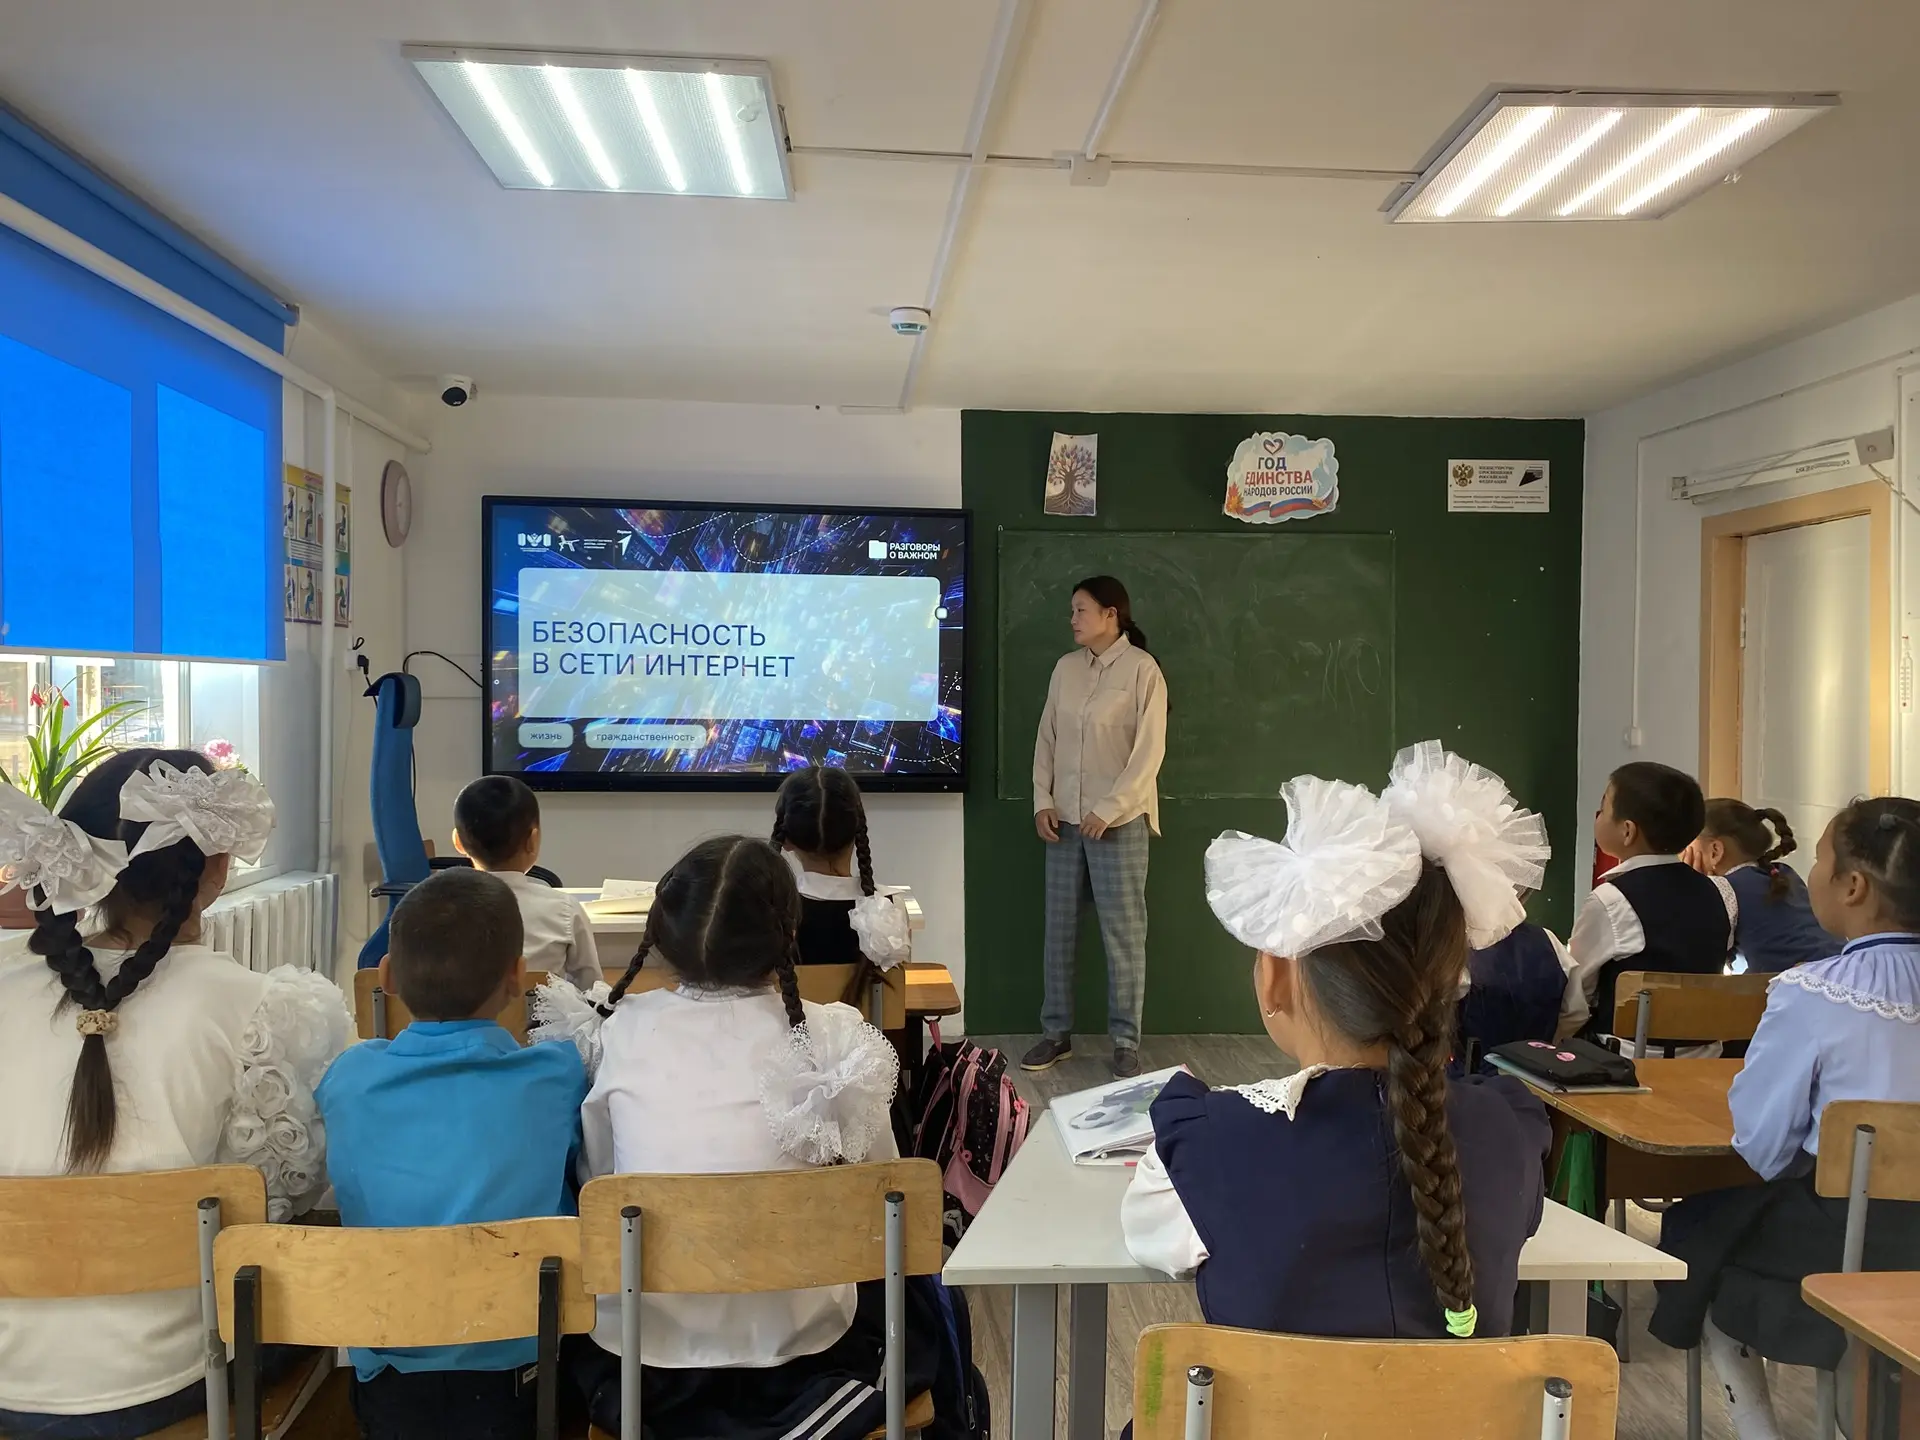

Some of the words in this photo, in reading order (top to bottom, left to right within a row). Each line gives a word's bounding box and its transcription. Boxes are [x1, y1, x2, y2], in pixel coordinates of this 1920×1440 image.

[1258, 457, 1287, 471] ГОД
[1245, 470, 1313, 487] ЕДИНСТВА
[1243, 487, 1277, 497] НАРОДОВ
[1279, 486, 1313, 495] РОССИИ
[890, 543, 941, 551] РАЗГОВОРЫ
[889, 551, 896, 559] О
[898, 551, 938, 560] ВАЖНОМ
[532, 621, 766, 646] БЕЗОПАСНОСТЬ
[532, 653, 550, 674] В
[559, 653, 635, 676] СЕТИ
[645, 654, 795, 678] ИНТЕРНЕТ
[530, 733, 562, 741] жизнь
[596, 733, 696, 743] гражданственность
